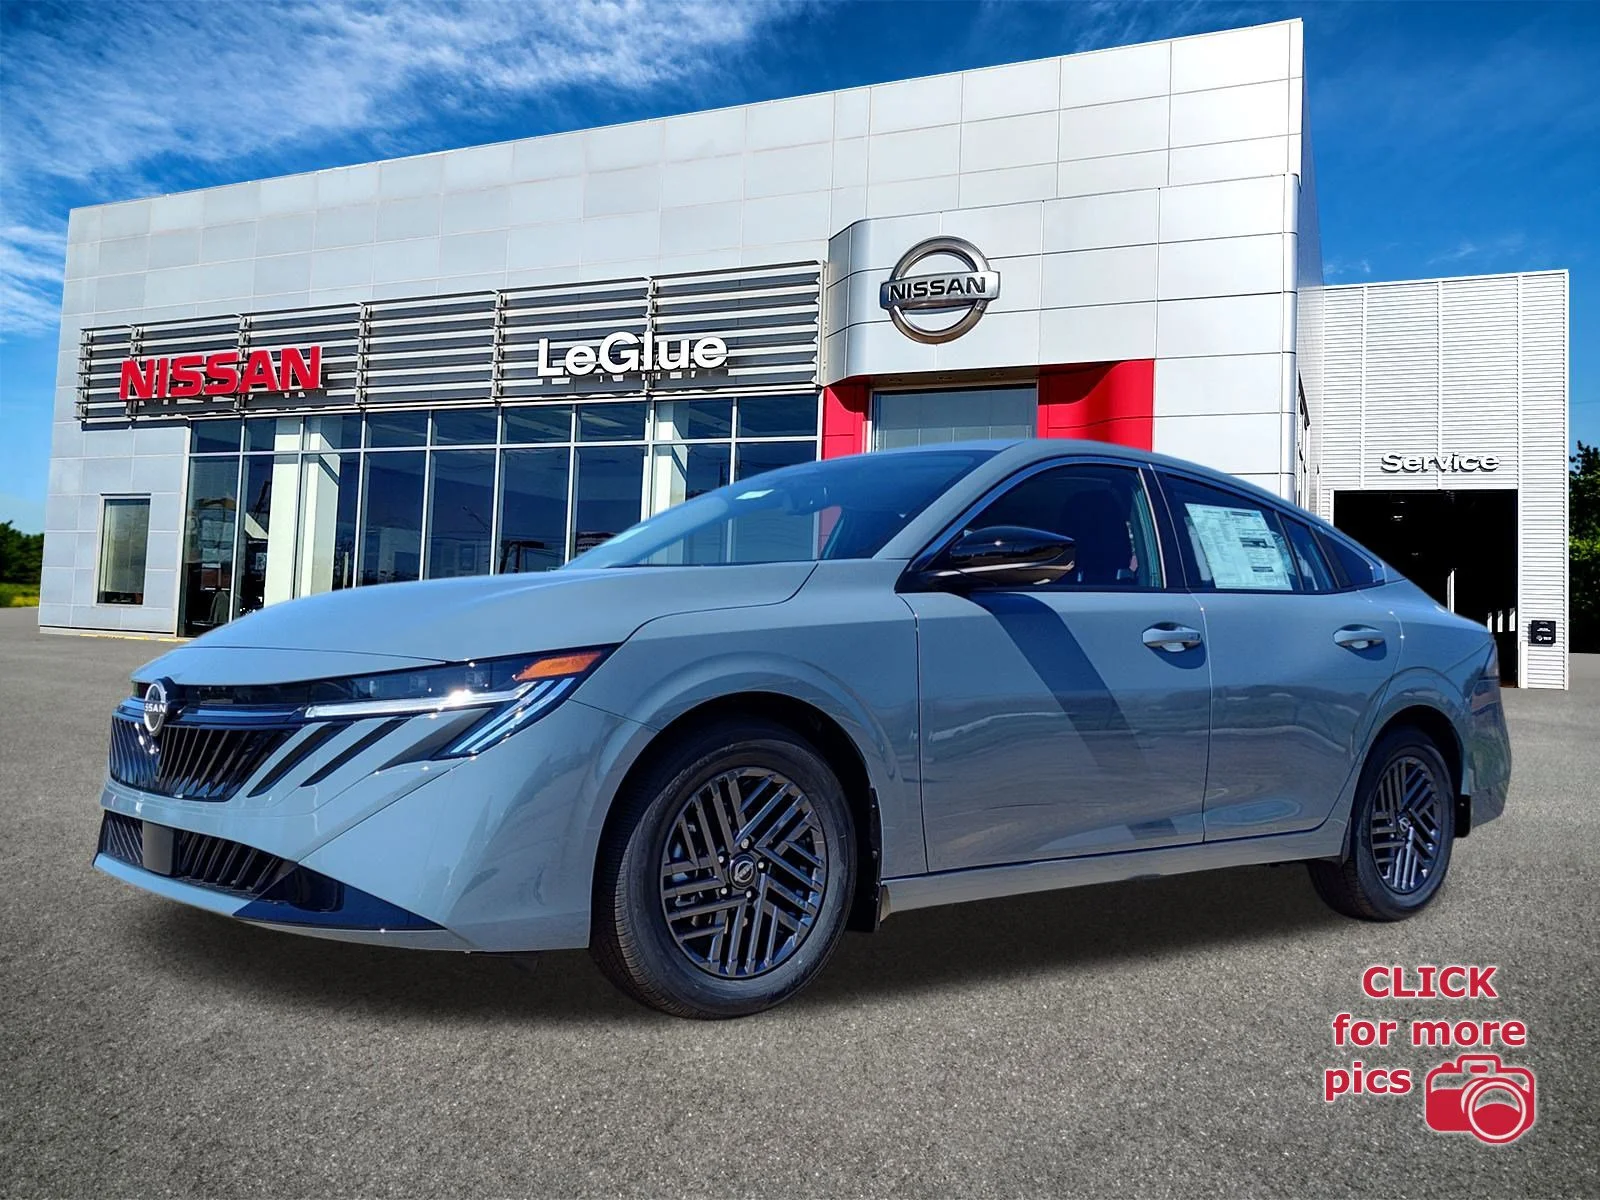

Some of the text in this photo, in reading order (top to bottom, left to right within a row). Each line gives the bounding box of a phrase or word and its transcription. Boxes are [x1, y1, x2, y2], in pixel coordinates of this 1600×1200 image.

[888, 276, 986, 301] NISSAN
[537, 331, 728, 377] LeGlue
[119, 346, 323, 400] NISSAN
[1381, 451, 1500, 473] Service
